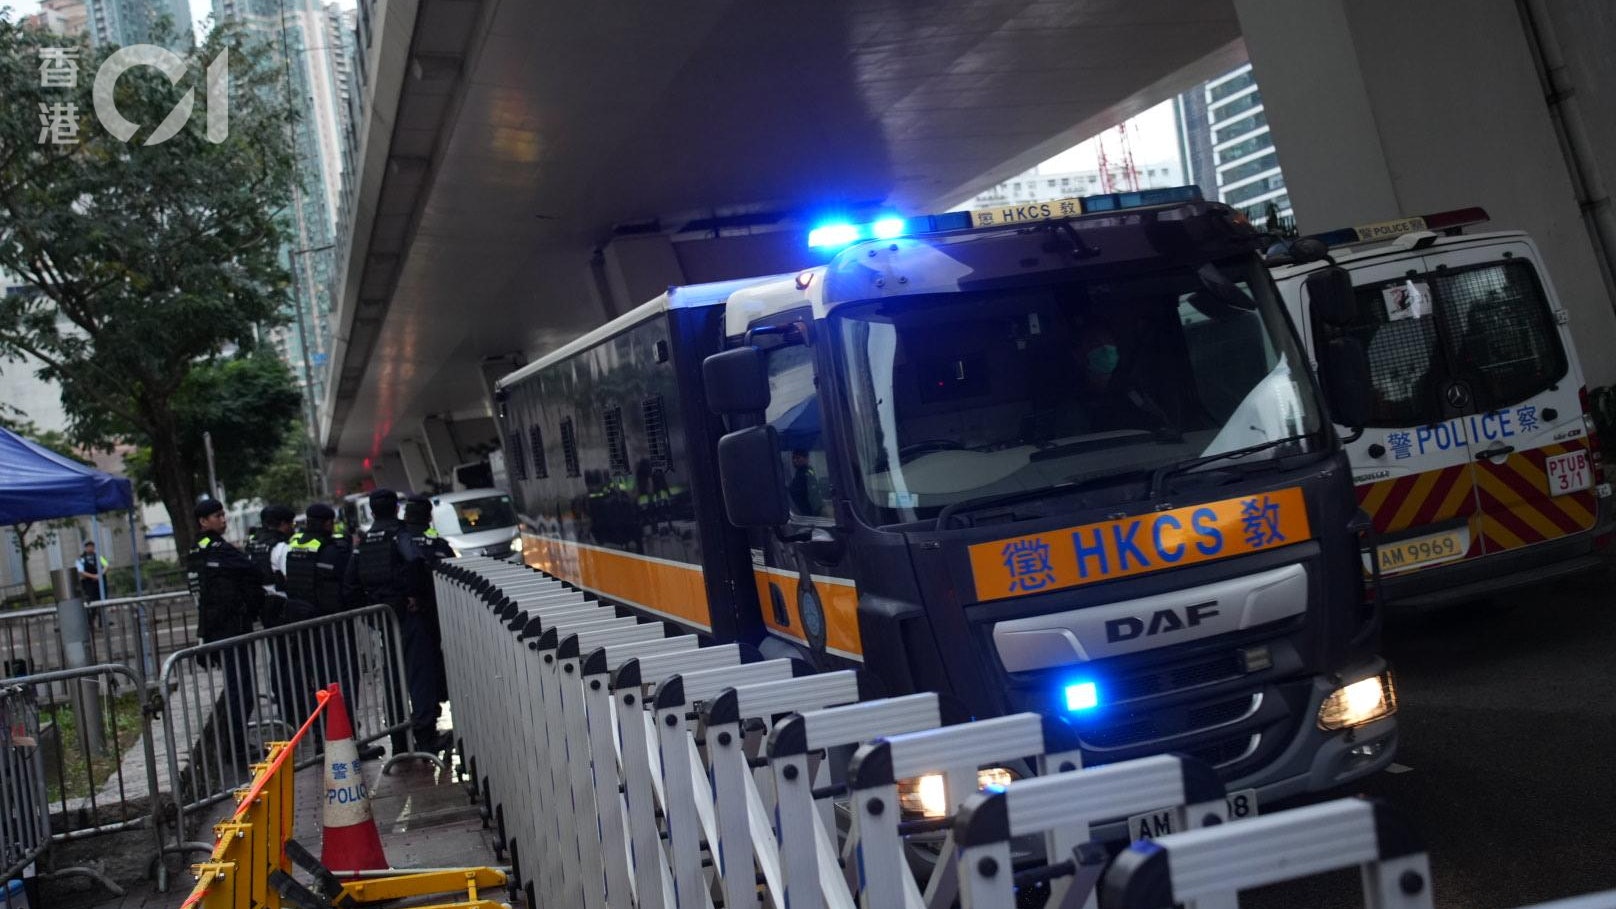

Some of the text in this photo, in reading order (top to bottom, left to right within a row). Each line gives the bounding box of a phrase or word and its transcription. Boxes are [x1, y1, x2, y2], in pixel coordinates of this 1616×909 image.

[1002, 204, 1051, 222] HKCS
[1374, 222, 1409, 236] POLICE
[1387, 404, 1540, 460] 警 POLICE 察
[1549, 454, 1586, 477] PTUB
[1558, 471, 1583, 490] 3/1
[1001, 537, 1057, 594] 懲
[1071, 507, 1223, 579] HKCS
[1382, 537, 1454, 567] AM 9969
[1104, 599, 1220, 645] DAF
[1139, 795, 1250, 839] AM 8
